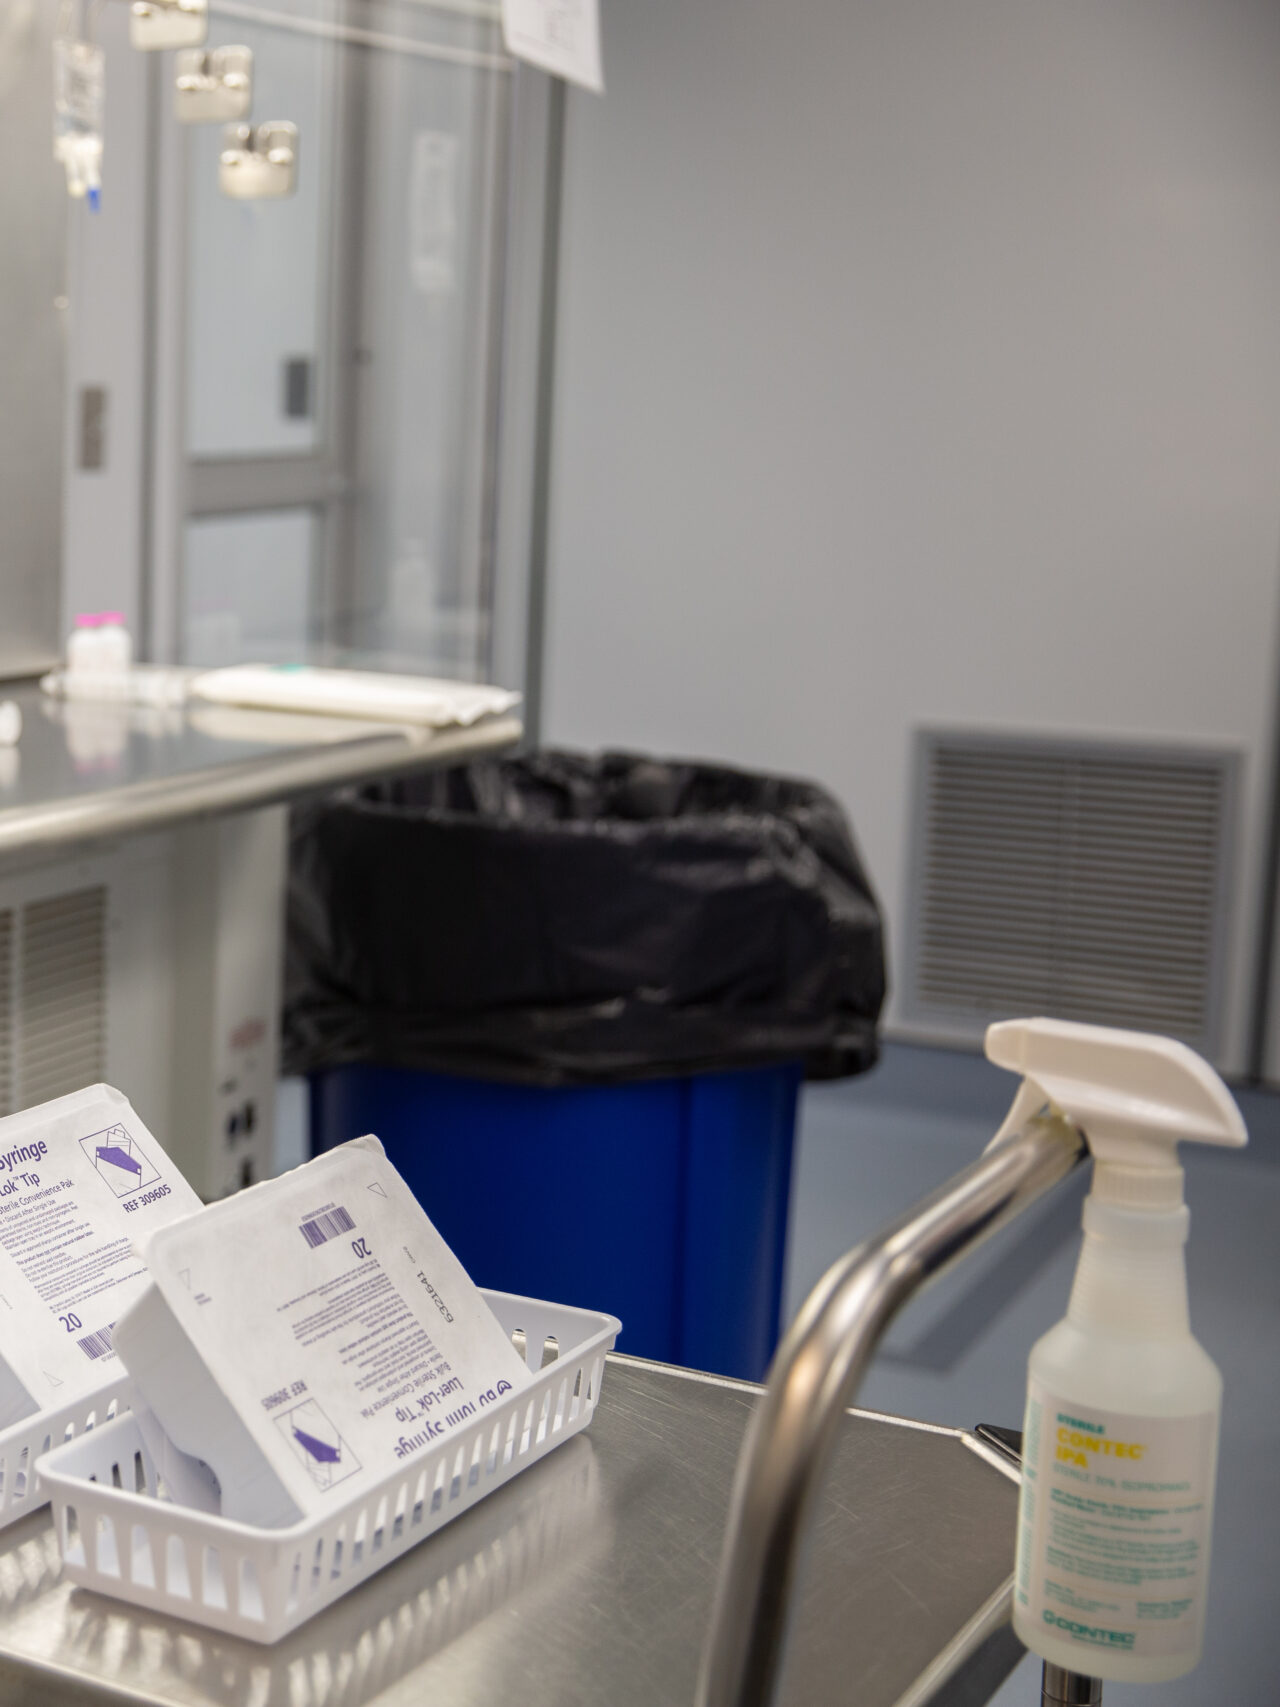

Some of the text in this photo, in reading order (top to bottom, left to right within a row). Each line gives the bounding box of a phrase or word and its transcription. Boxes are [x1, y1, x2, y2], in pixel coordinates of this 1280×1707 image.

[22, 1173, 40, 1187] Tip
[18, 1185, 62, 1206] Convenience
[59, 1178, 75, 1189] Pak
[122, 1184, 172, 1213] REF 309605
[351, 1237, 372, 1259] 20
[58, 1313, 82, 1333] 20
[291, 1379, 308, 1396] REF
[395, 1406, 416, 1423] Tip
[1056, 1427, 1144, 1460] CONTEC
[1055, 1444, 1088, 1469] IPA
[1056, 1616, 1136, 1645] CONTEC
